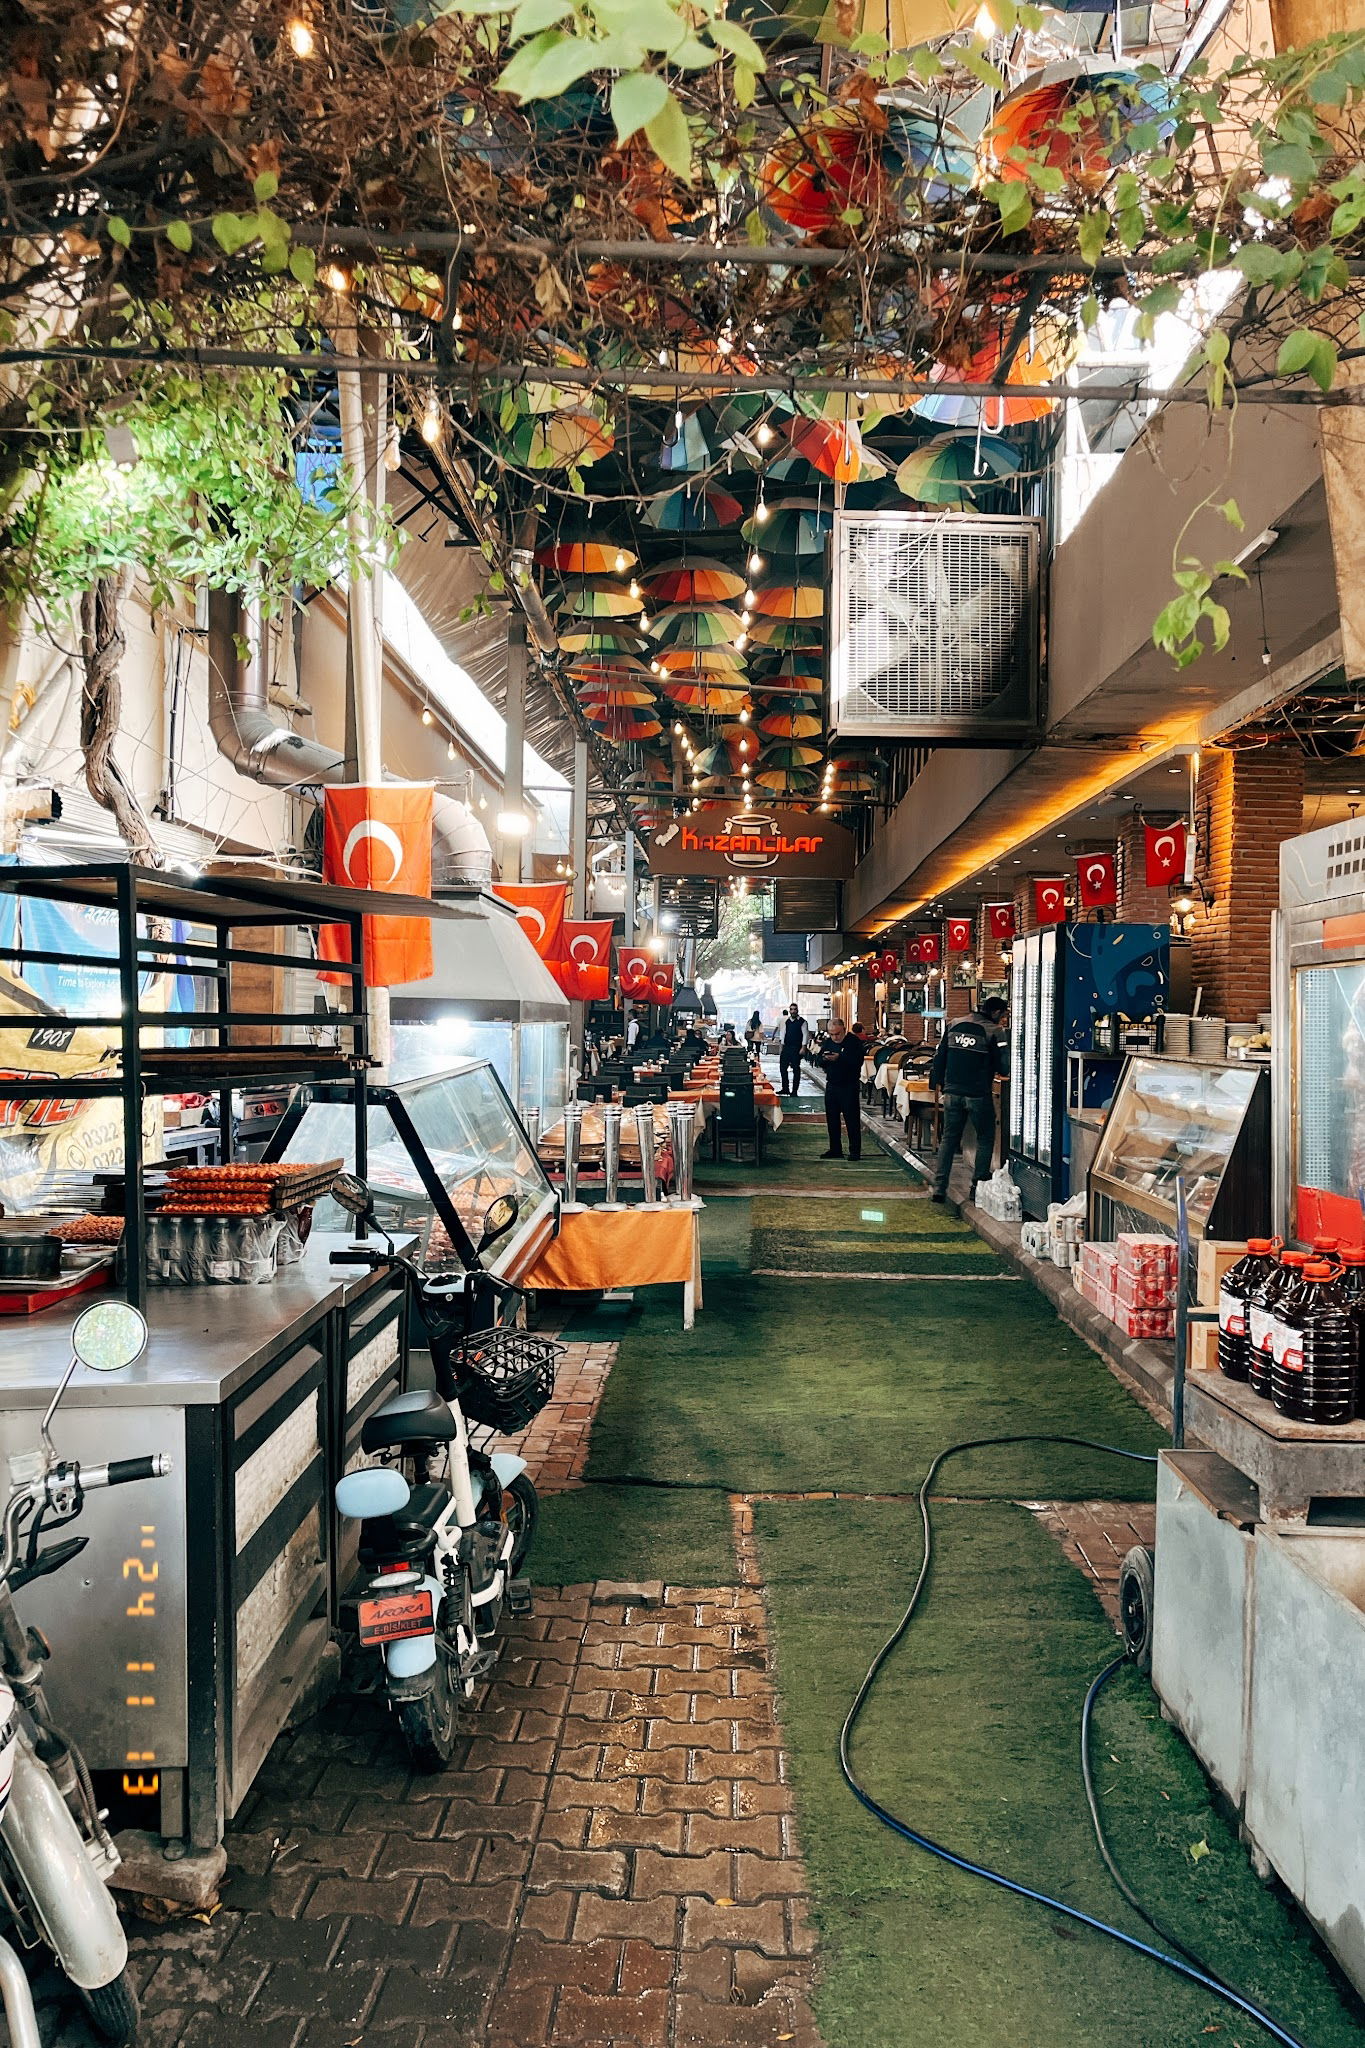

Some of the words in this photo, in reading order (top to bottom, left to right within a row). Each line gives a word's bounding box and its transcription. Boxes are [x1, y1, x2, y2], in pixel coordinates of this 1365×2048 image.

[58, 976, 77, 987] Time
[32, 1028, 73, 1047] 1908
[955, 1033, 976, 1048] vigo
[82, 1122, 118, 1148] 0322
[369, 1603, 424, 1620] ARORA
